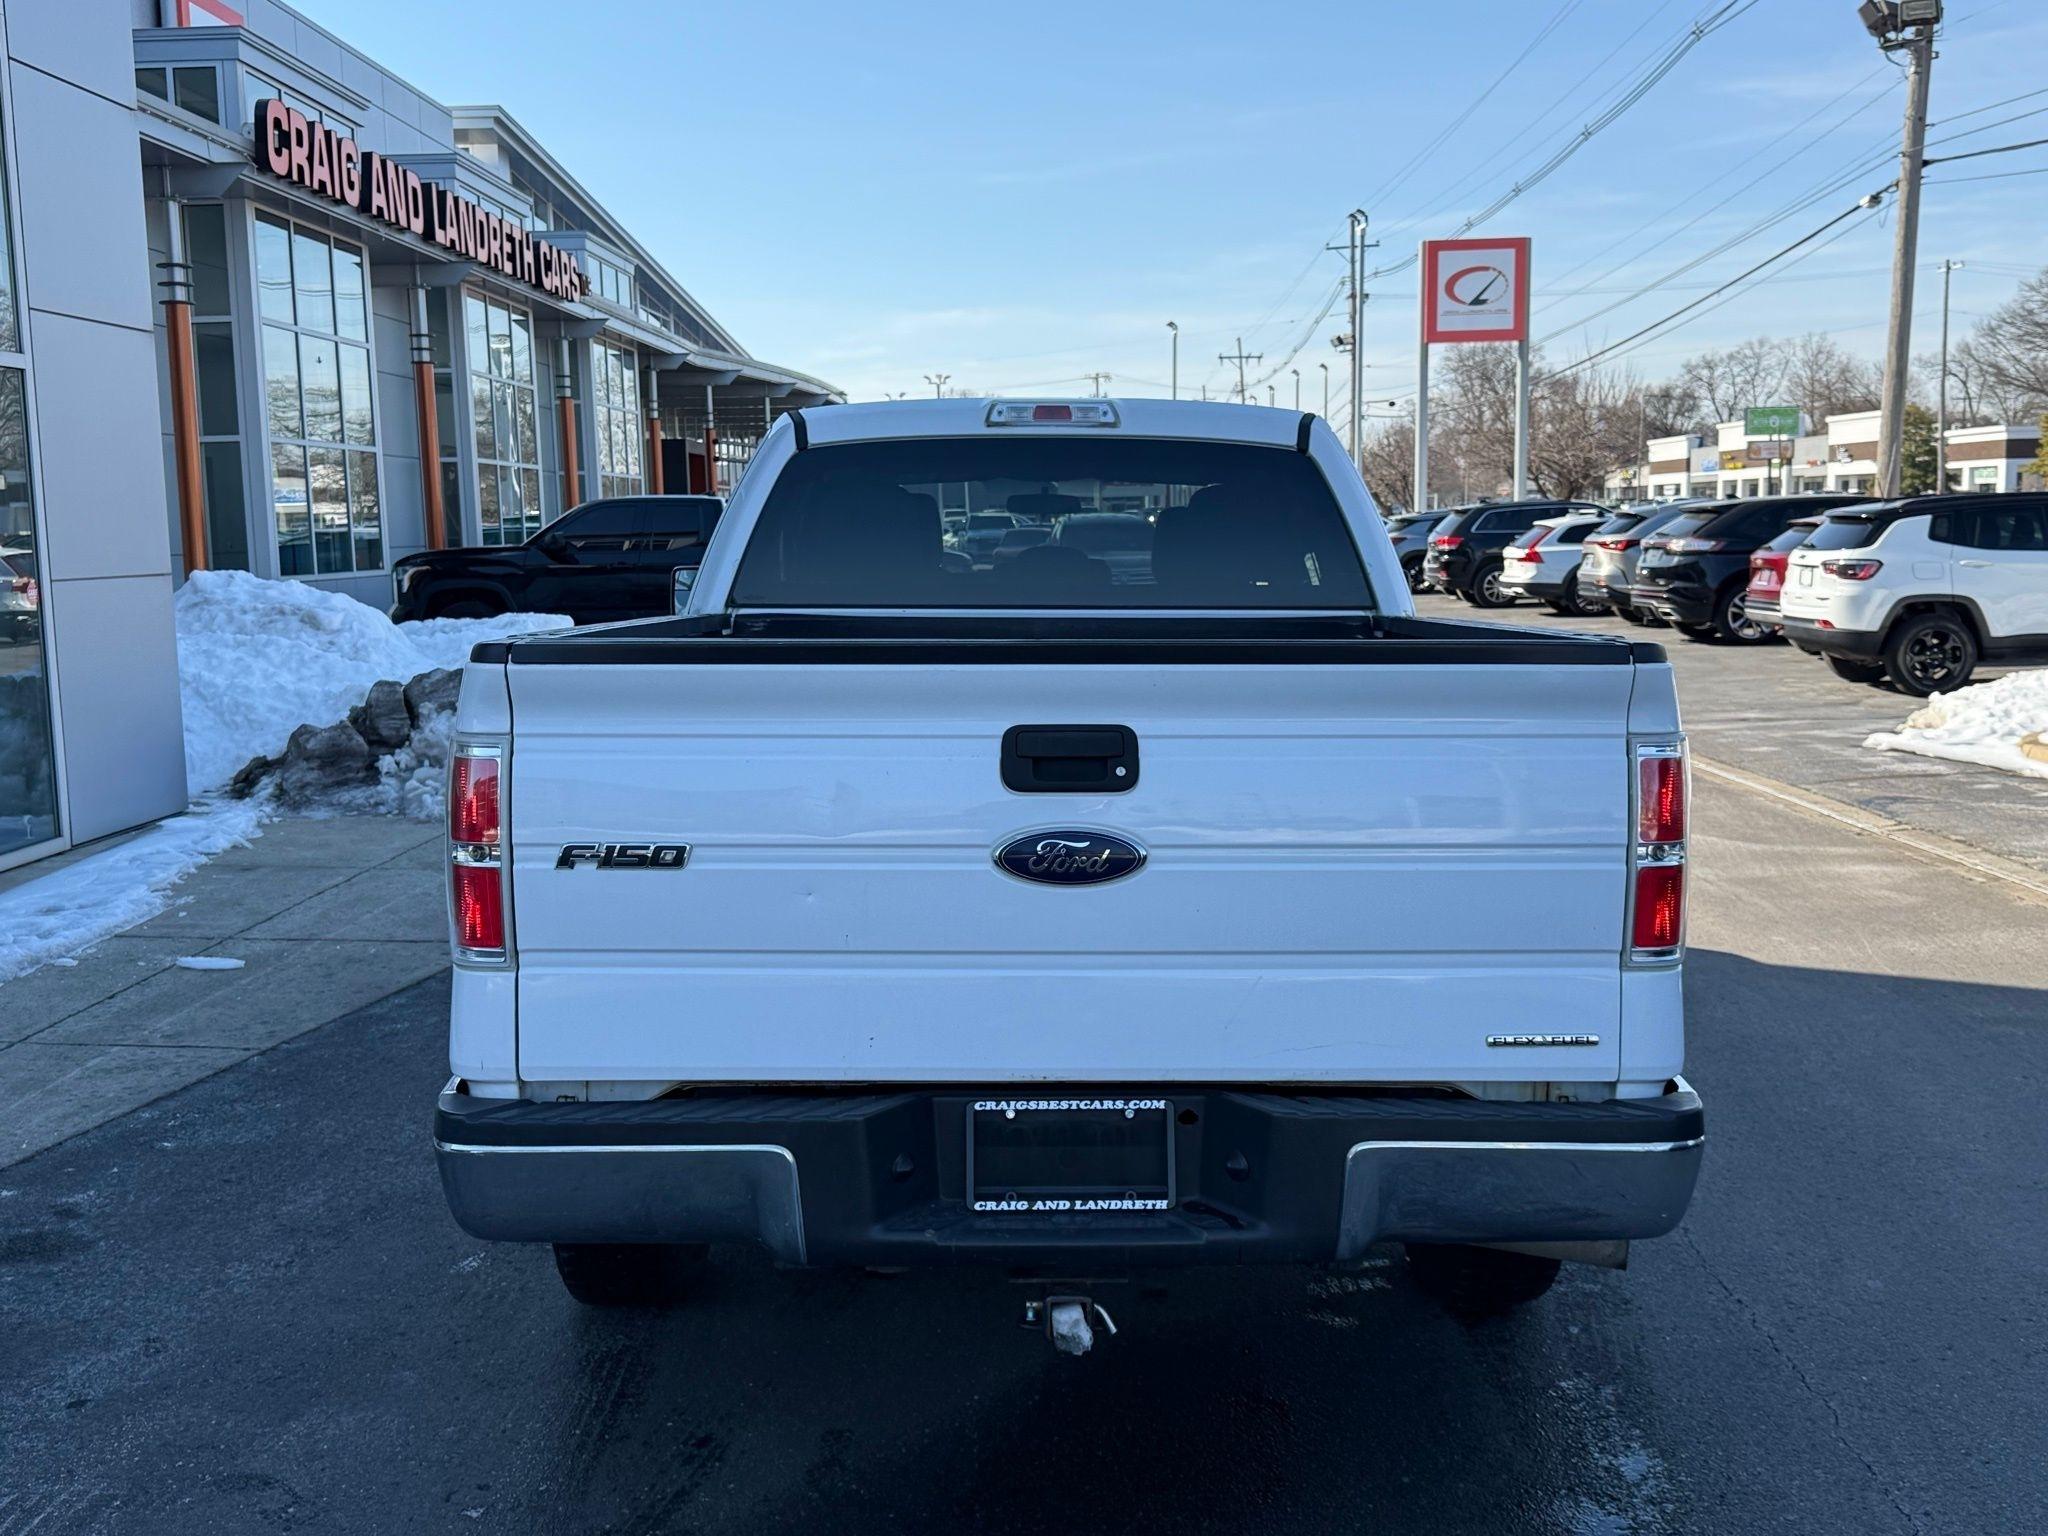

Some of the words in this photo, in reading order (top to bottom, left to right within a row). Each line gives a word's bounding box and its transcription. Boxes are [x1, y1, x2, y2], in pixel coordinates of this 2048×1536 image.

[265, 98, 361, 208] CRAIG
[371, 151, 425, 235] AND
[431, 181, 537, 285] LANDRETH
[539, 238, 581, 303] CARS
[555, 841, 693, 870] F-150
[1028, 838, 1111, 873] Ford
[1492, 1036, 1537, 1046] FLEX
[1551, 1036, 1594, 1046] FUEL
[974, 1100, 1167, 1111] CRAIGSBESTCARS.COM
[973, 1200, 1029, 1211] CRAIG
[1032, 1200, 1071, 1211] AND
[1074, 1200, 1168, 1211] LANDRETH
